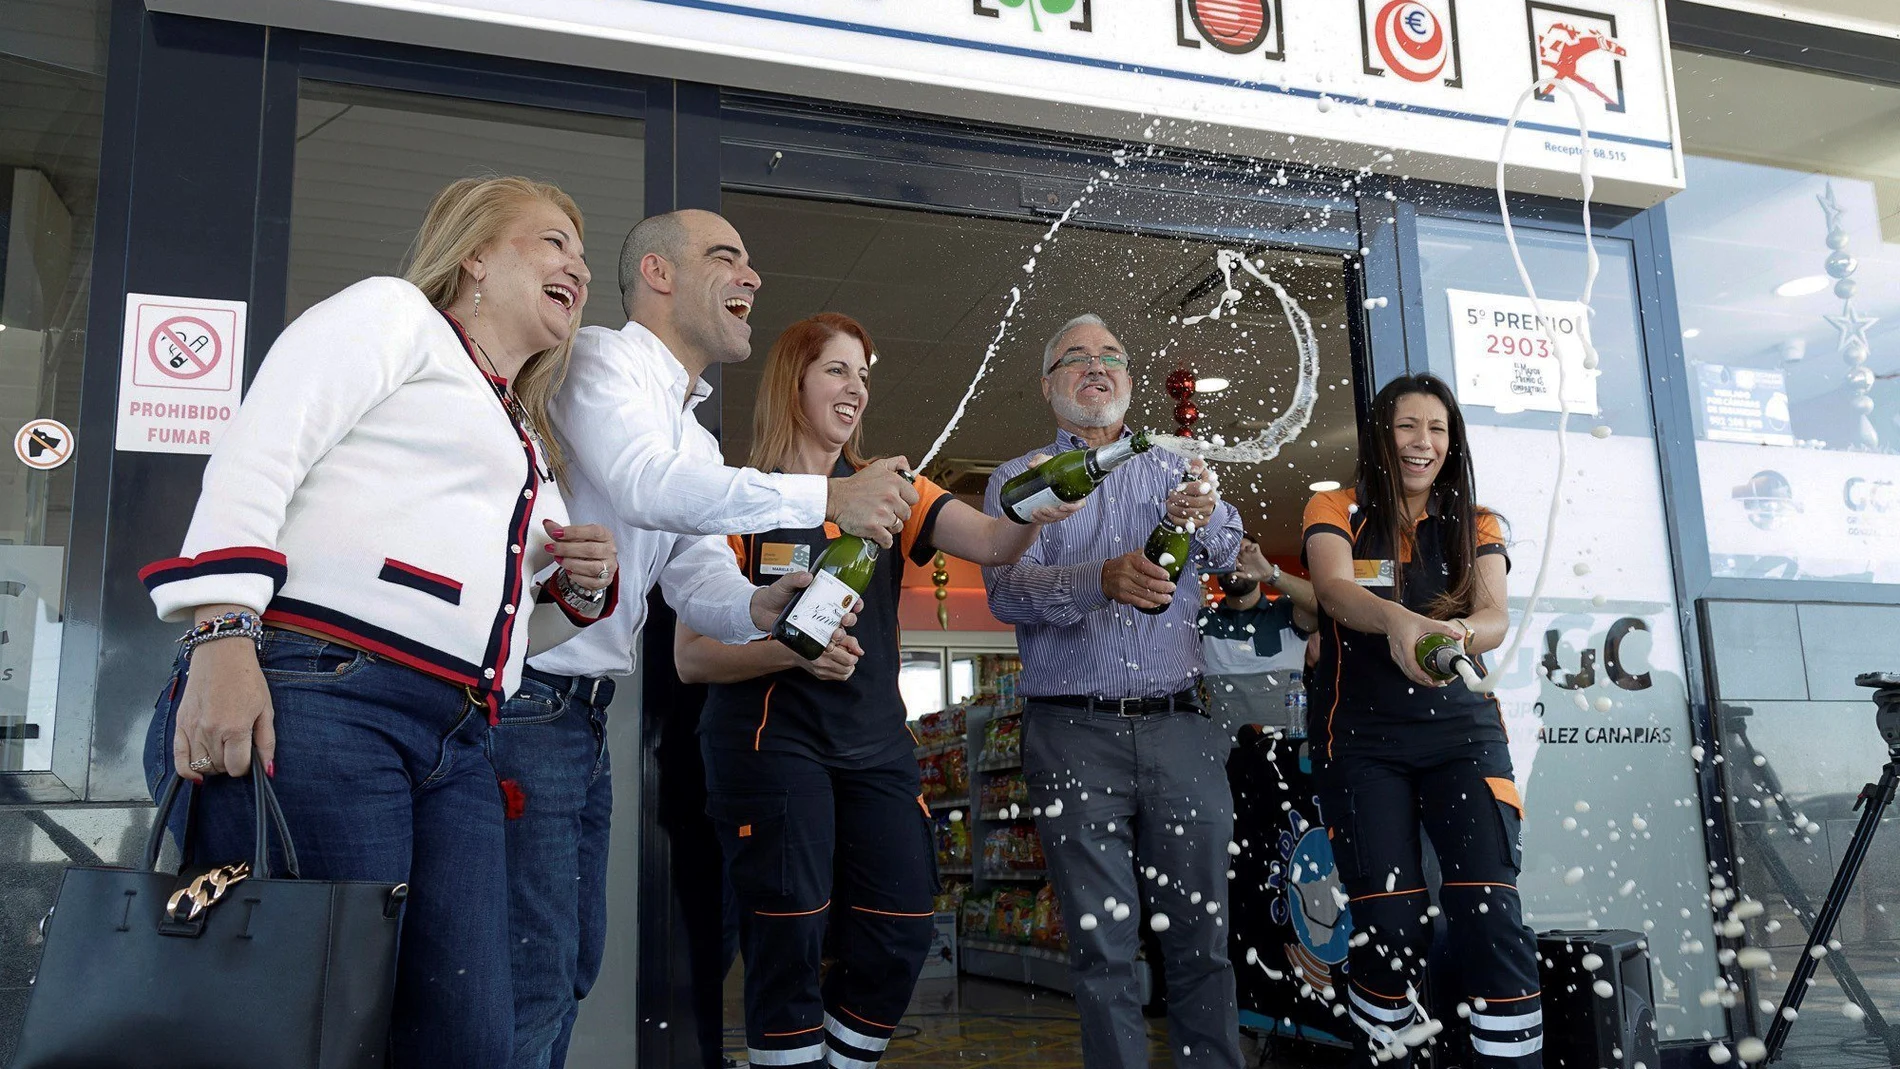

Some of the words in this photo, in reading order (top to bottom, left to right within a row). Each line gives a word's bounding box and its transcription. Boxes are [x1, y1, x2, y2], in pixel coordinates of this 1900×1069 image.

[1544, 141, 1590, 157] Recepto
[1593, 147, 1627, 162] 68.515
[1494, 311, 1573, 334] PREMIO
[1487, 334, 1555, 358] 2903
[129, 401, 231, 421] PROHIBIDO
[147, 427, 211, 445] FUMAR
